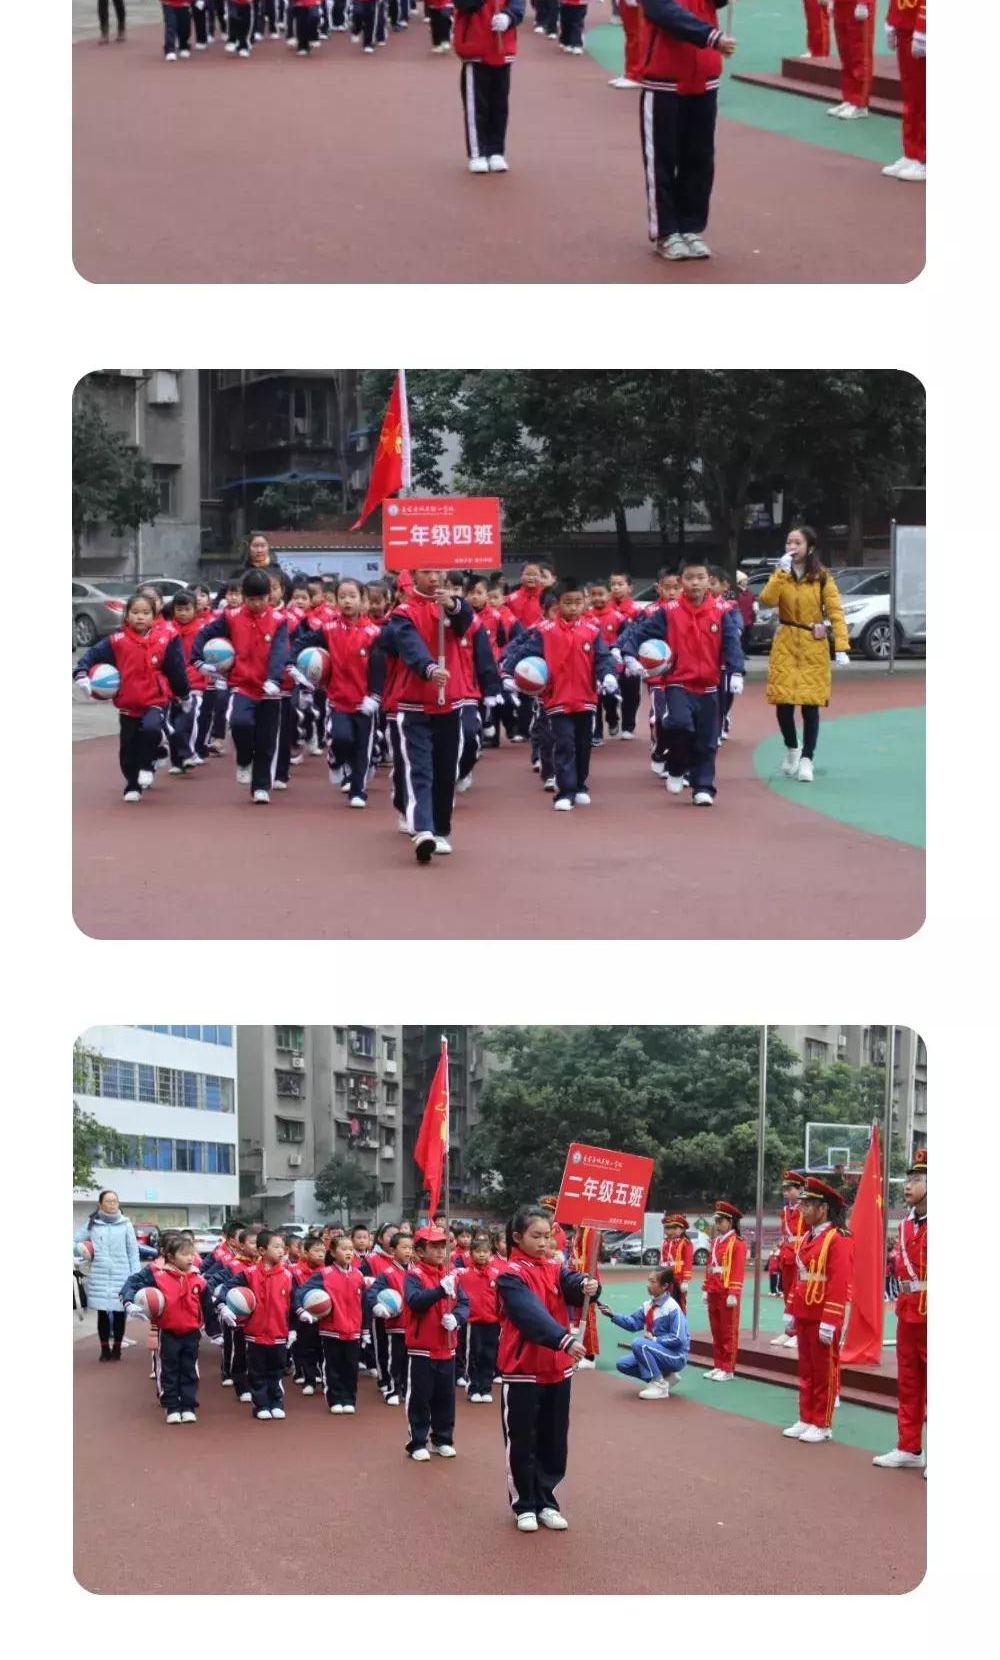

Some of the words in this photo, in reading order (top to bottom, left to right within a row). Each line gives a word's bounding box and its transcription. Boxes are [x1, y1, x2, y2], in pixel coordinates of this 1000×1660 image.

[389, 524, 494, 547] 二年级四班
[564, 1175, 644, 1208] 二年级五班
